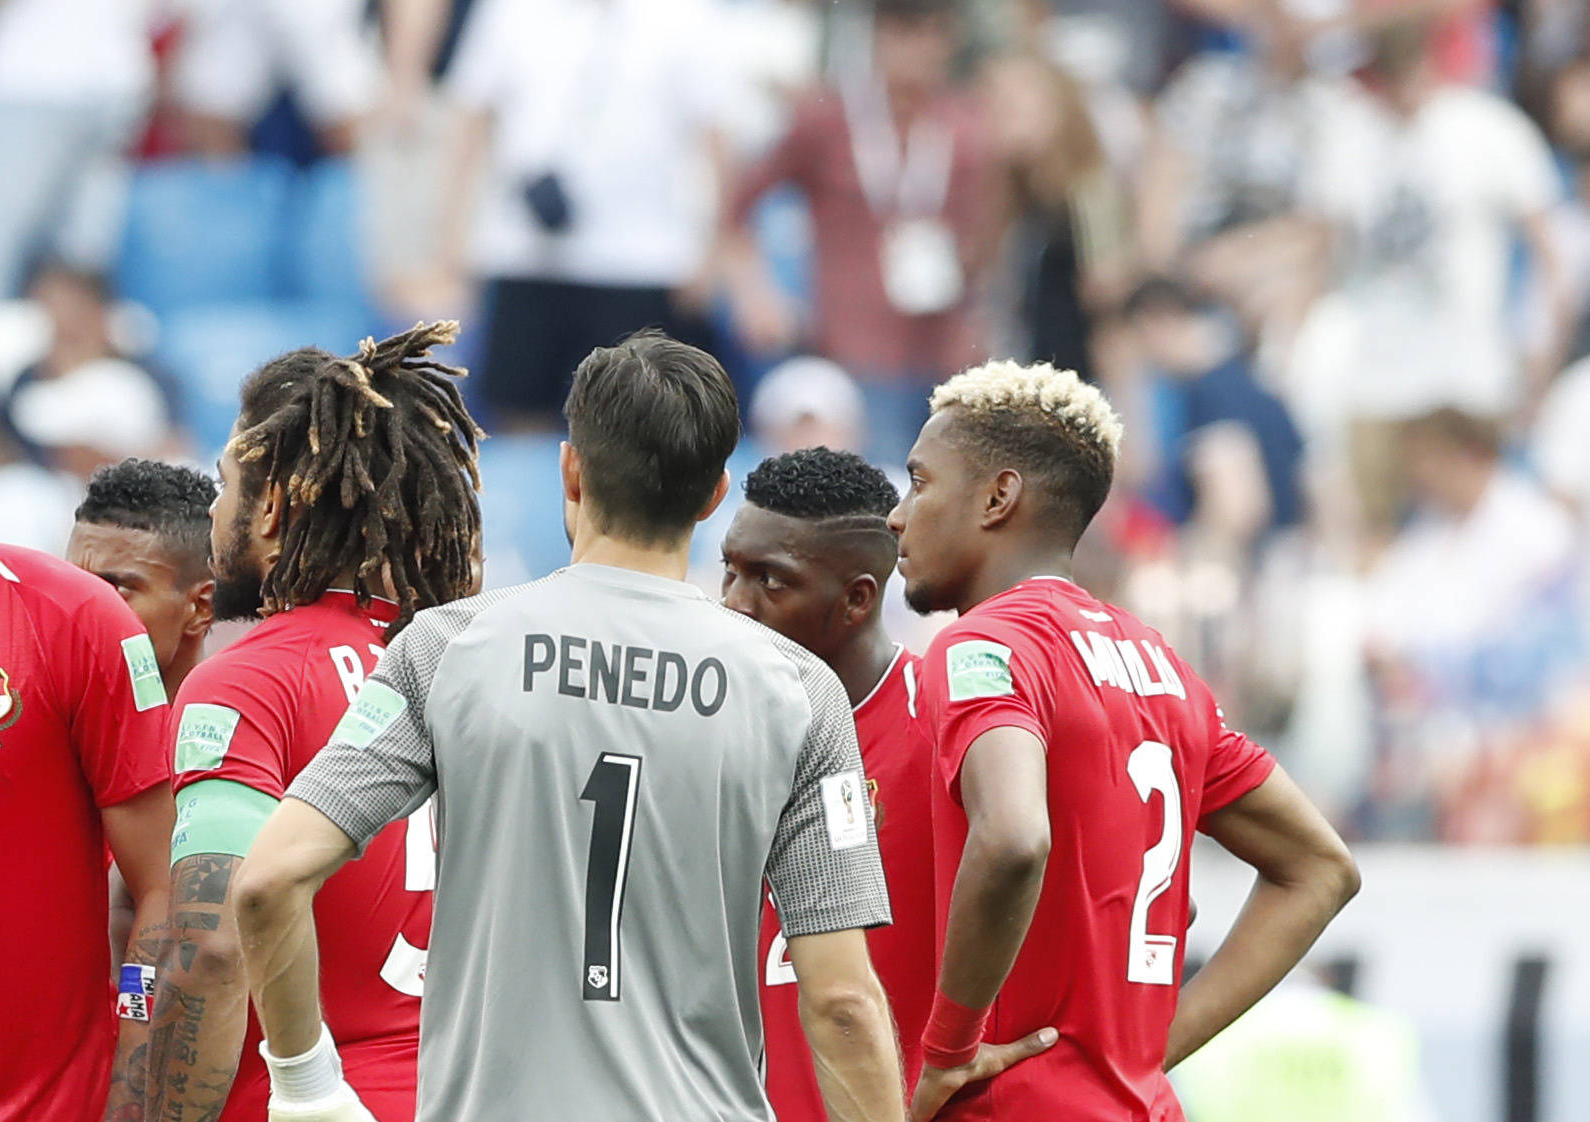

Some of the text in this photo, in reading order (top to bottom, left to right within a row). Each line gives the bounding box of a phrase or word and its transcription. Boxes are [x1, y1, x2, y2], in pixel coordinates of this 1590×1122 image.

[522, 633, 728, 718] PENEDO
[579, 751, 643, 1001] 1
[1127, 741, 1183, 985] 2
